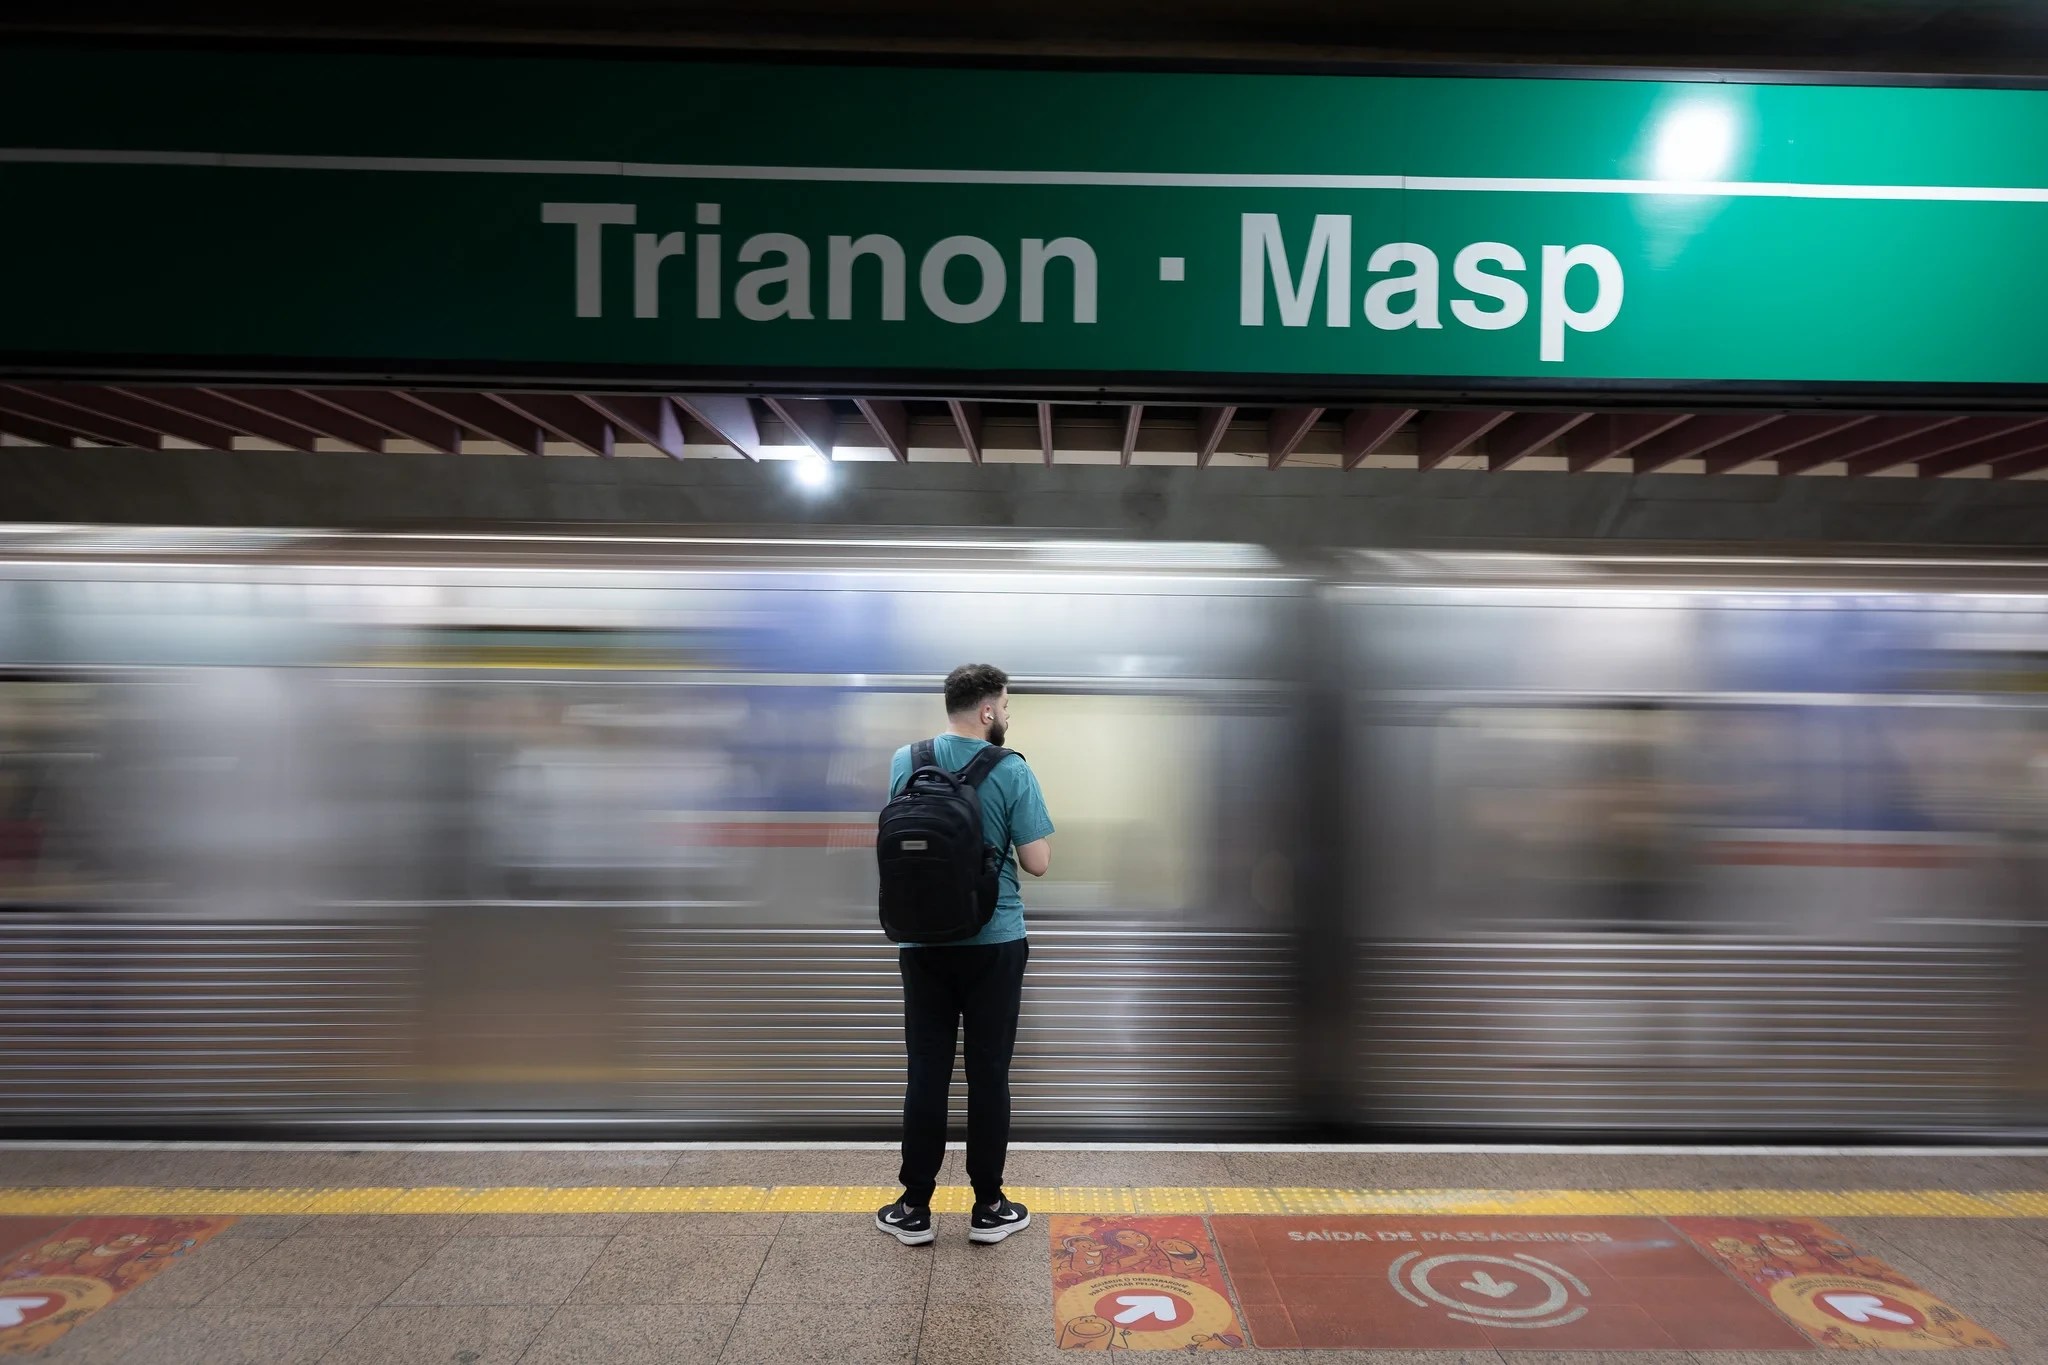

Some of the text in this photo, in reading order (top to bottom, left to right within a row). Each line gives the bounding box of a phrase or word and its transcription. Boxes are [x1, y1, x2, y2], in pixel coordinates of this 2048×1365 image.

[541, 202, 1097, 324] Trianon
[1240, 213, 1624, 362] Masp
[1288, 1229, 1613, 1243] SAÍDA DE PASSAGEIROS
